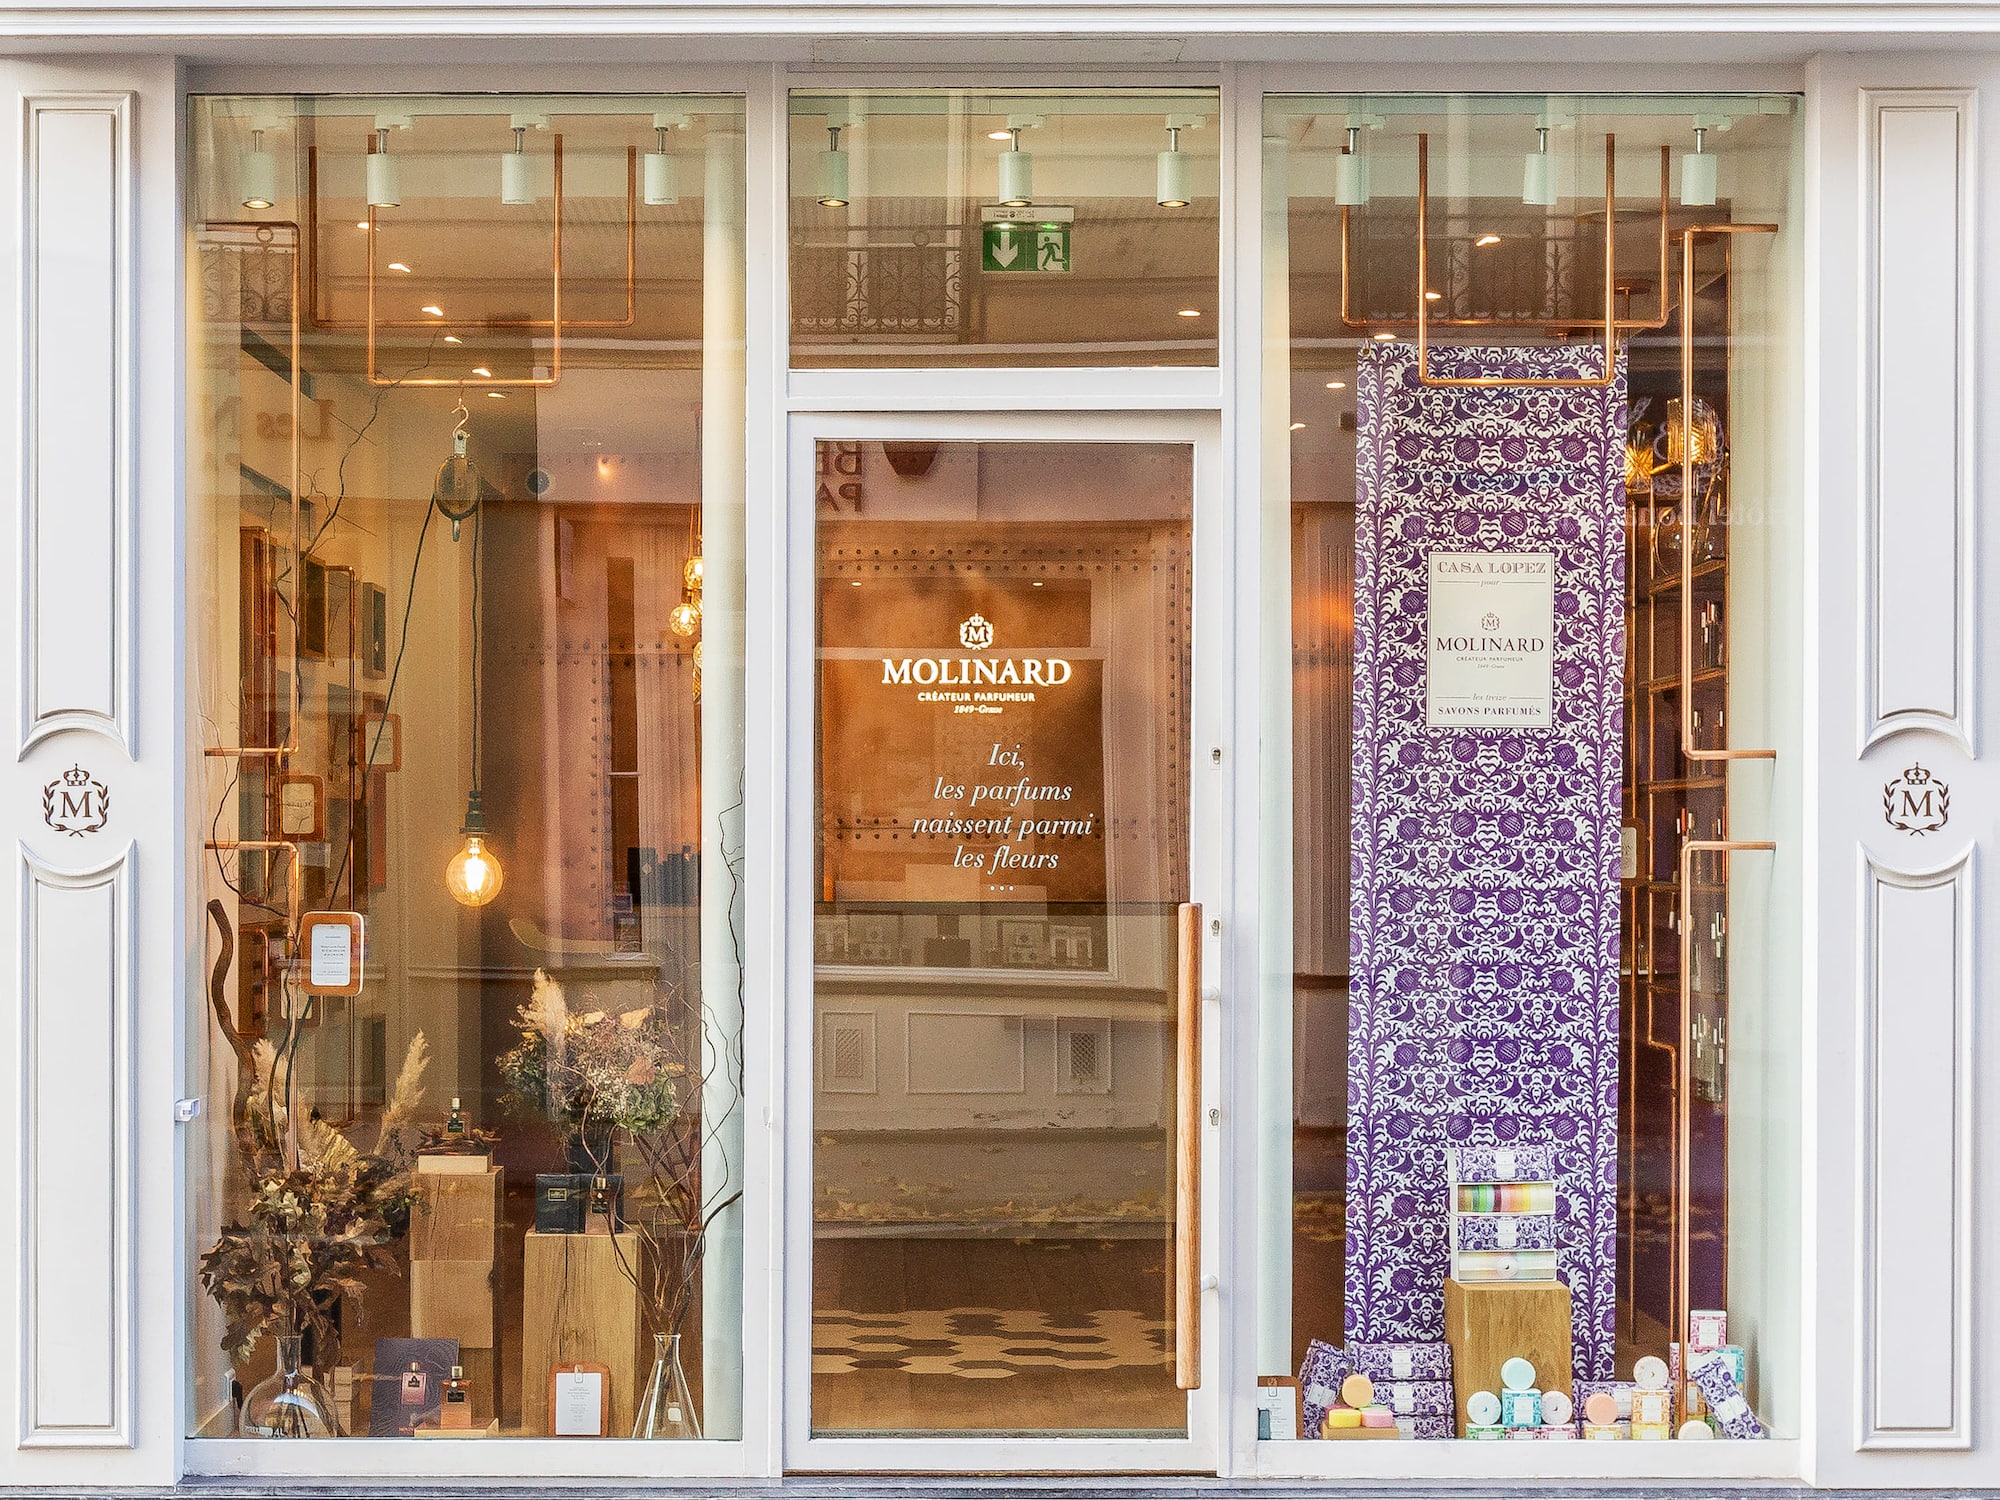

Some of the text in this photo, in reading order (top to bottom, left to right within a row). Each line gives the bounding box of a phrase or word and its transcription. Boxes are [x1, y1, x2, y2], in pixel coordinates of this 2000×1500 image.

[1437, 561, 1546, 574] CASA LOPEZ
[967, 626, 986, 642] M
[1436, 637, 1544, 653] MOLINARD
[881, 658, 1072, 687] MOLINARD
[917, 690, 1035, 702] CRÉATEUR PARFUMEUR
[1438, 704, 1541, 715] SAVONS PARFUMÉS
[987, 743, 1025, 770] Ici,
[60, 791, 93, 818] M
[933, 777, 1073, 807] les parfums
[1900, 790, 1934, 817] M
[912, 811, 1095, 842] naissent parmi
[952, 845, 1059, 875] les fleurs
